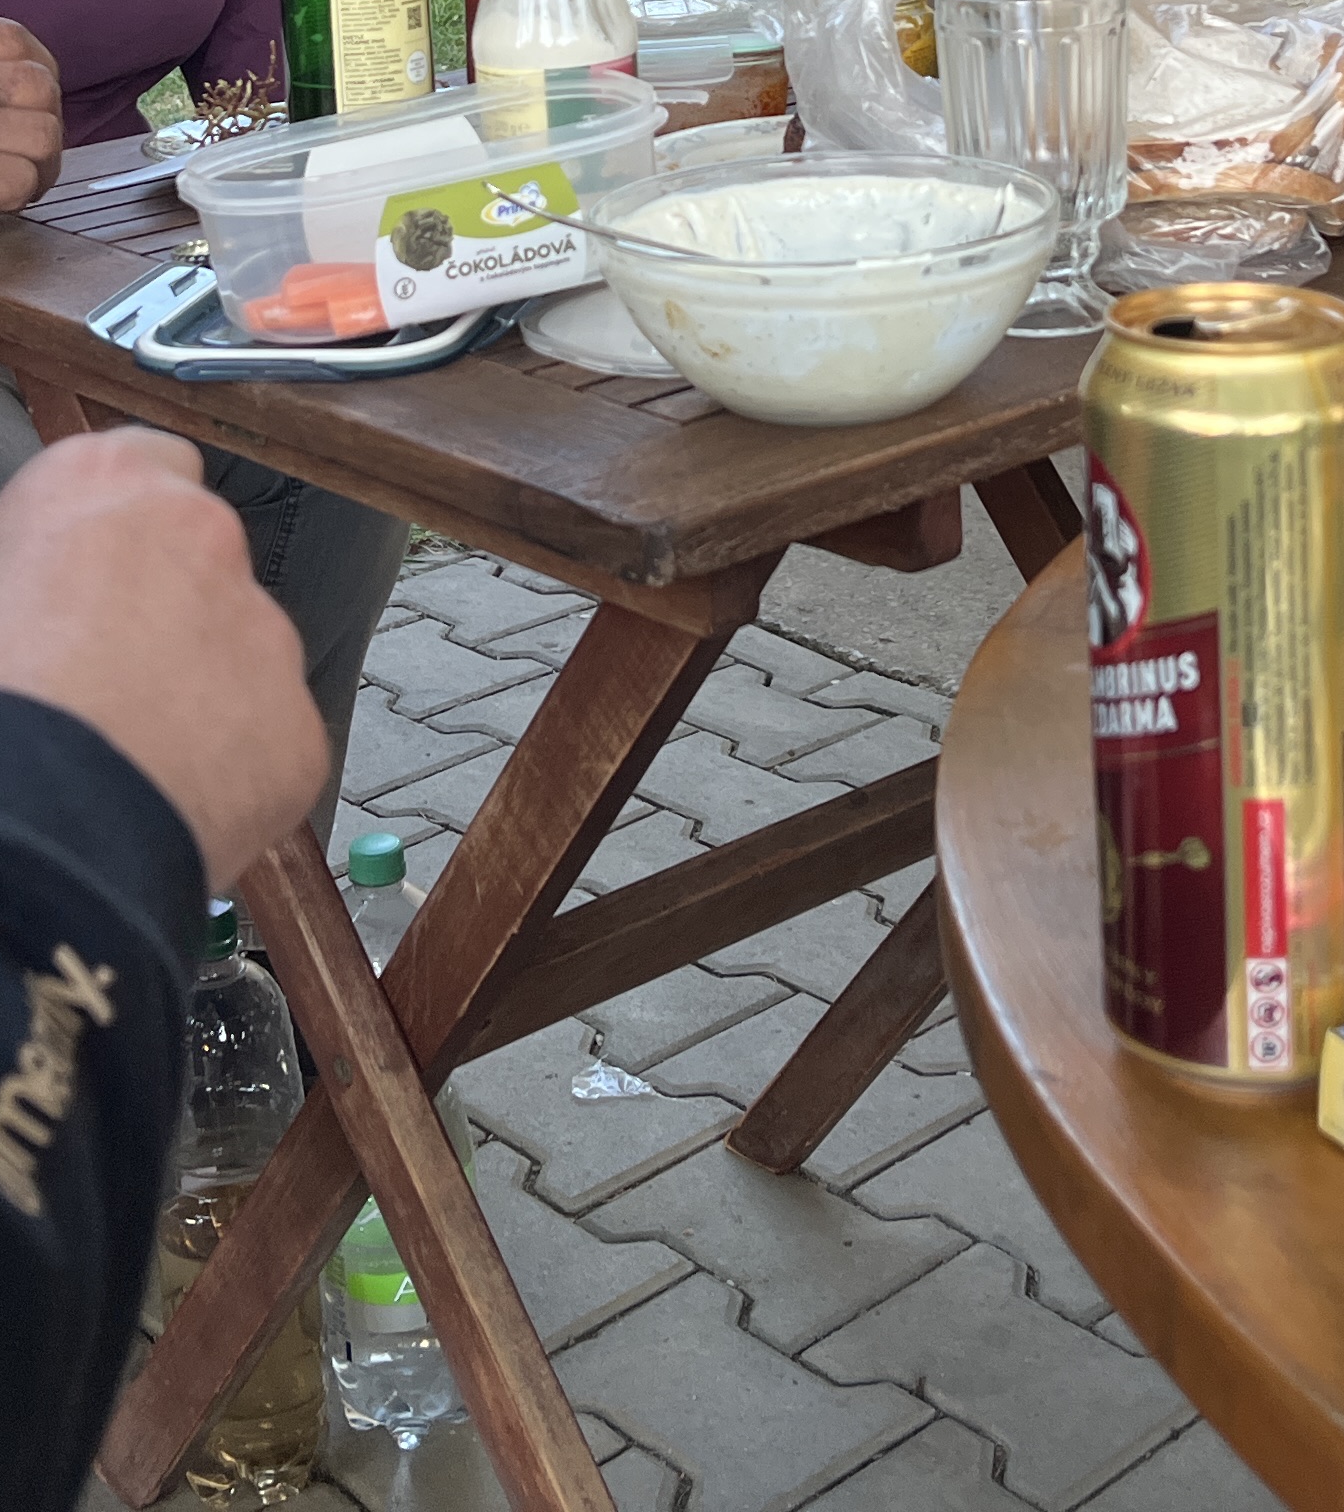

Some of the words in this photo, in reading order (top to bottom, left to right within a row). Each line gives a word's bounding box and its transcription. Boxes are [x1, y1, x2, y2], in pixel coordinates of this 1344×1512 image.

[445, 233, 576, 279] ČOKOLÁDOVÁ
[1092, 651, 1201, 699] MBRINUS
[1093, 695, 1179, 737] DARMA
